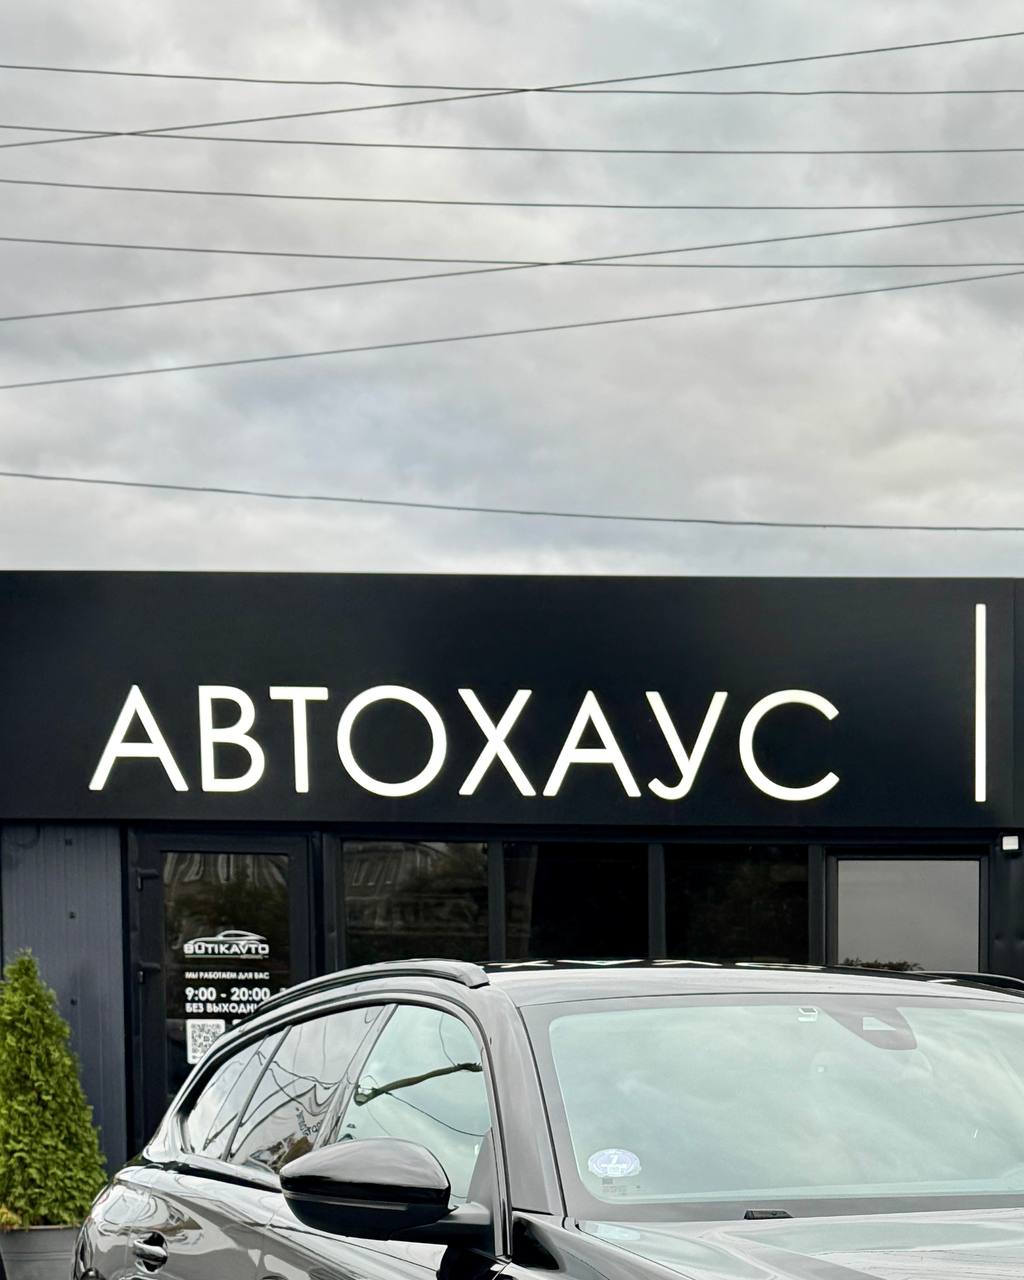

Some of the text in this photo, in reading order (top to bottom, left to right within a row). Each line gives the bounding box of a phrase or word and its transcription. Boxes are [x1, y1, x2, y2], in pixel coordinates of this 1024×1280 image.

[88, 684, 841, 801] АВТОХАУС
[183, 943, 270, 954] BUTIKAVTO
[185, 987, 216, 1001] 9:00
[230, 987, 270, 1001] 20:00
[185, 1003, 258, 1014] БЕЗ ВЫХОДН
